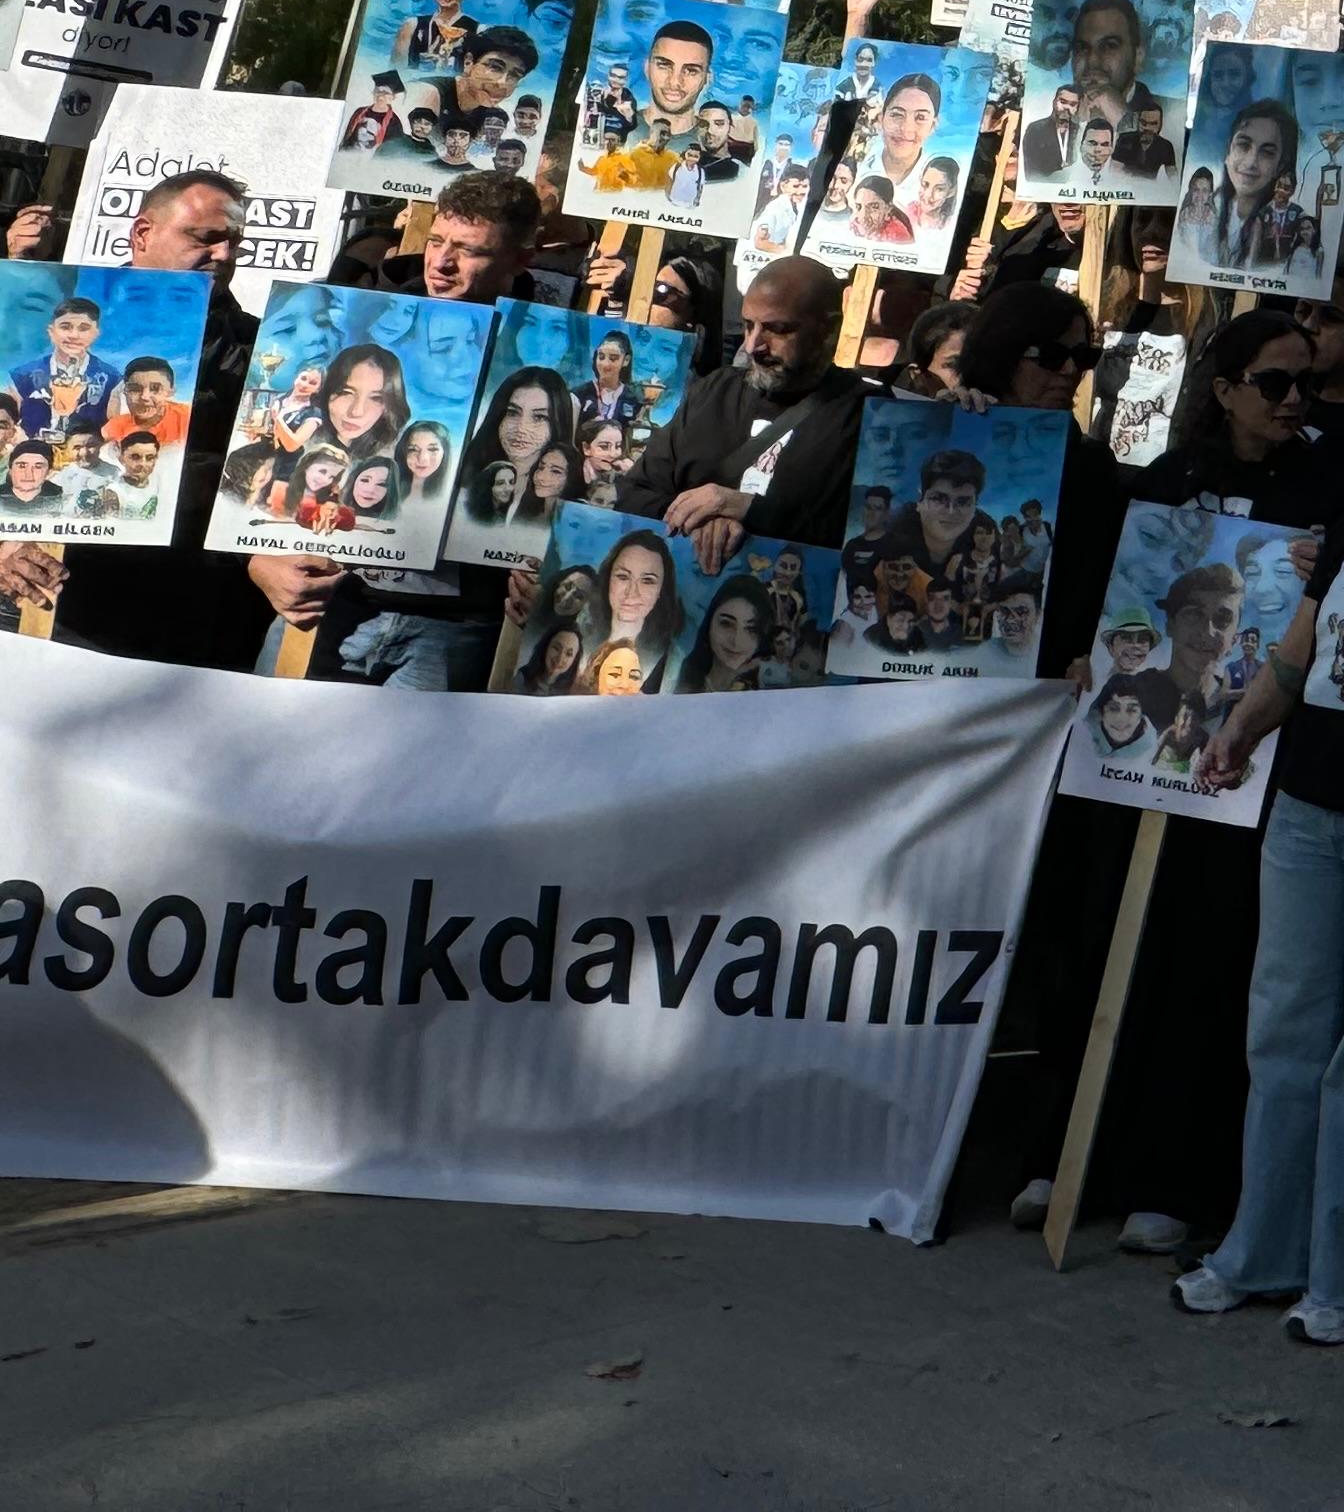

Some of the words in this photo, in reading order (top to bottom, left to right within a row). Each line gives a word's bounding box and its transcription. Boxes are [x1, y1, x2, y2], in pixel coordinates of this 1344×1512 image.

[244, 197, 317, 229] AST
[235, 240, 317, 272] CEK!
[0, 522, 43, 536] ASAN
